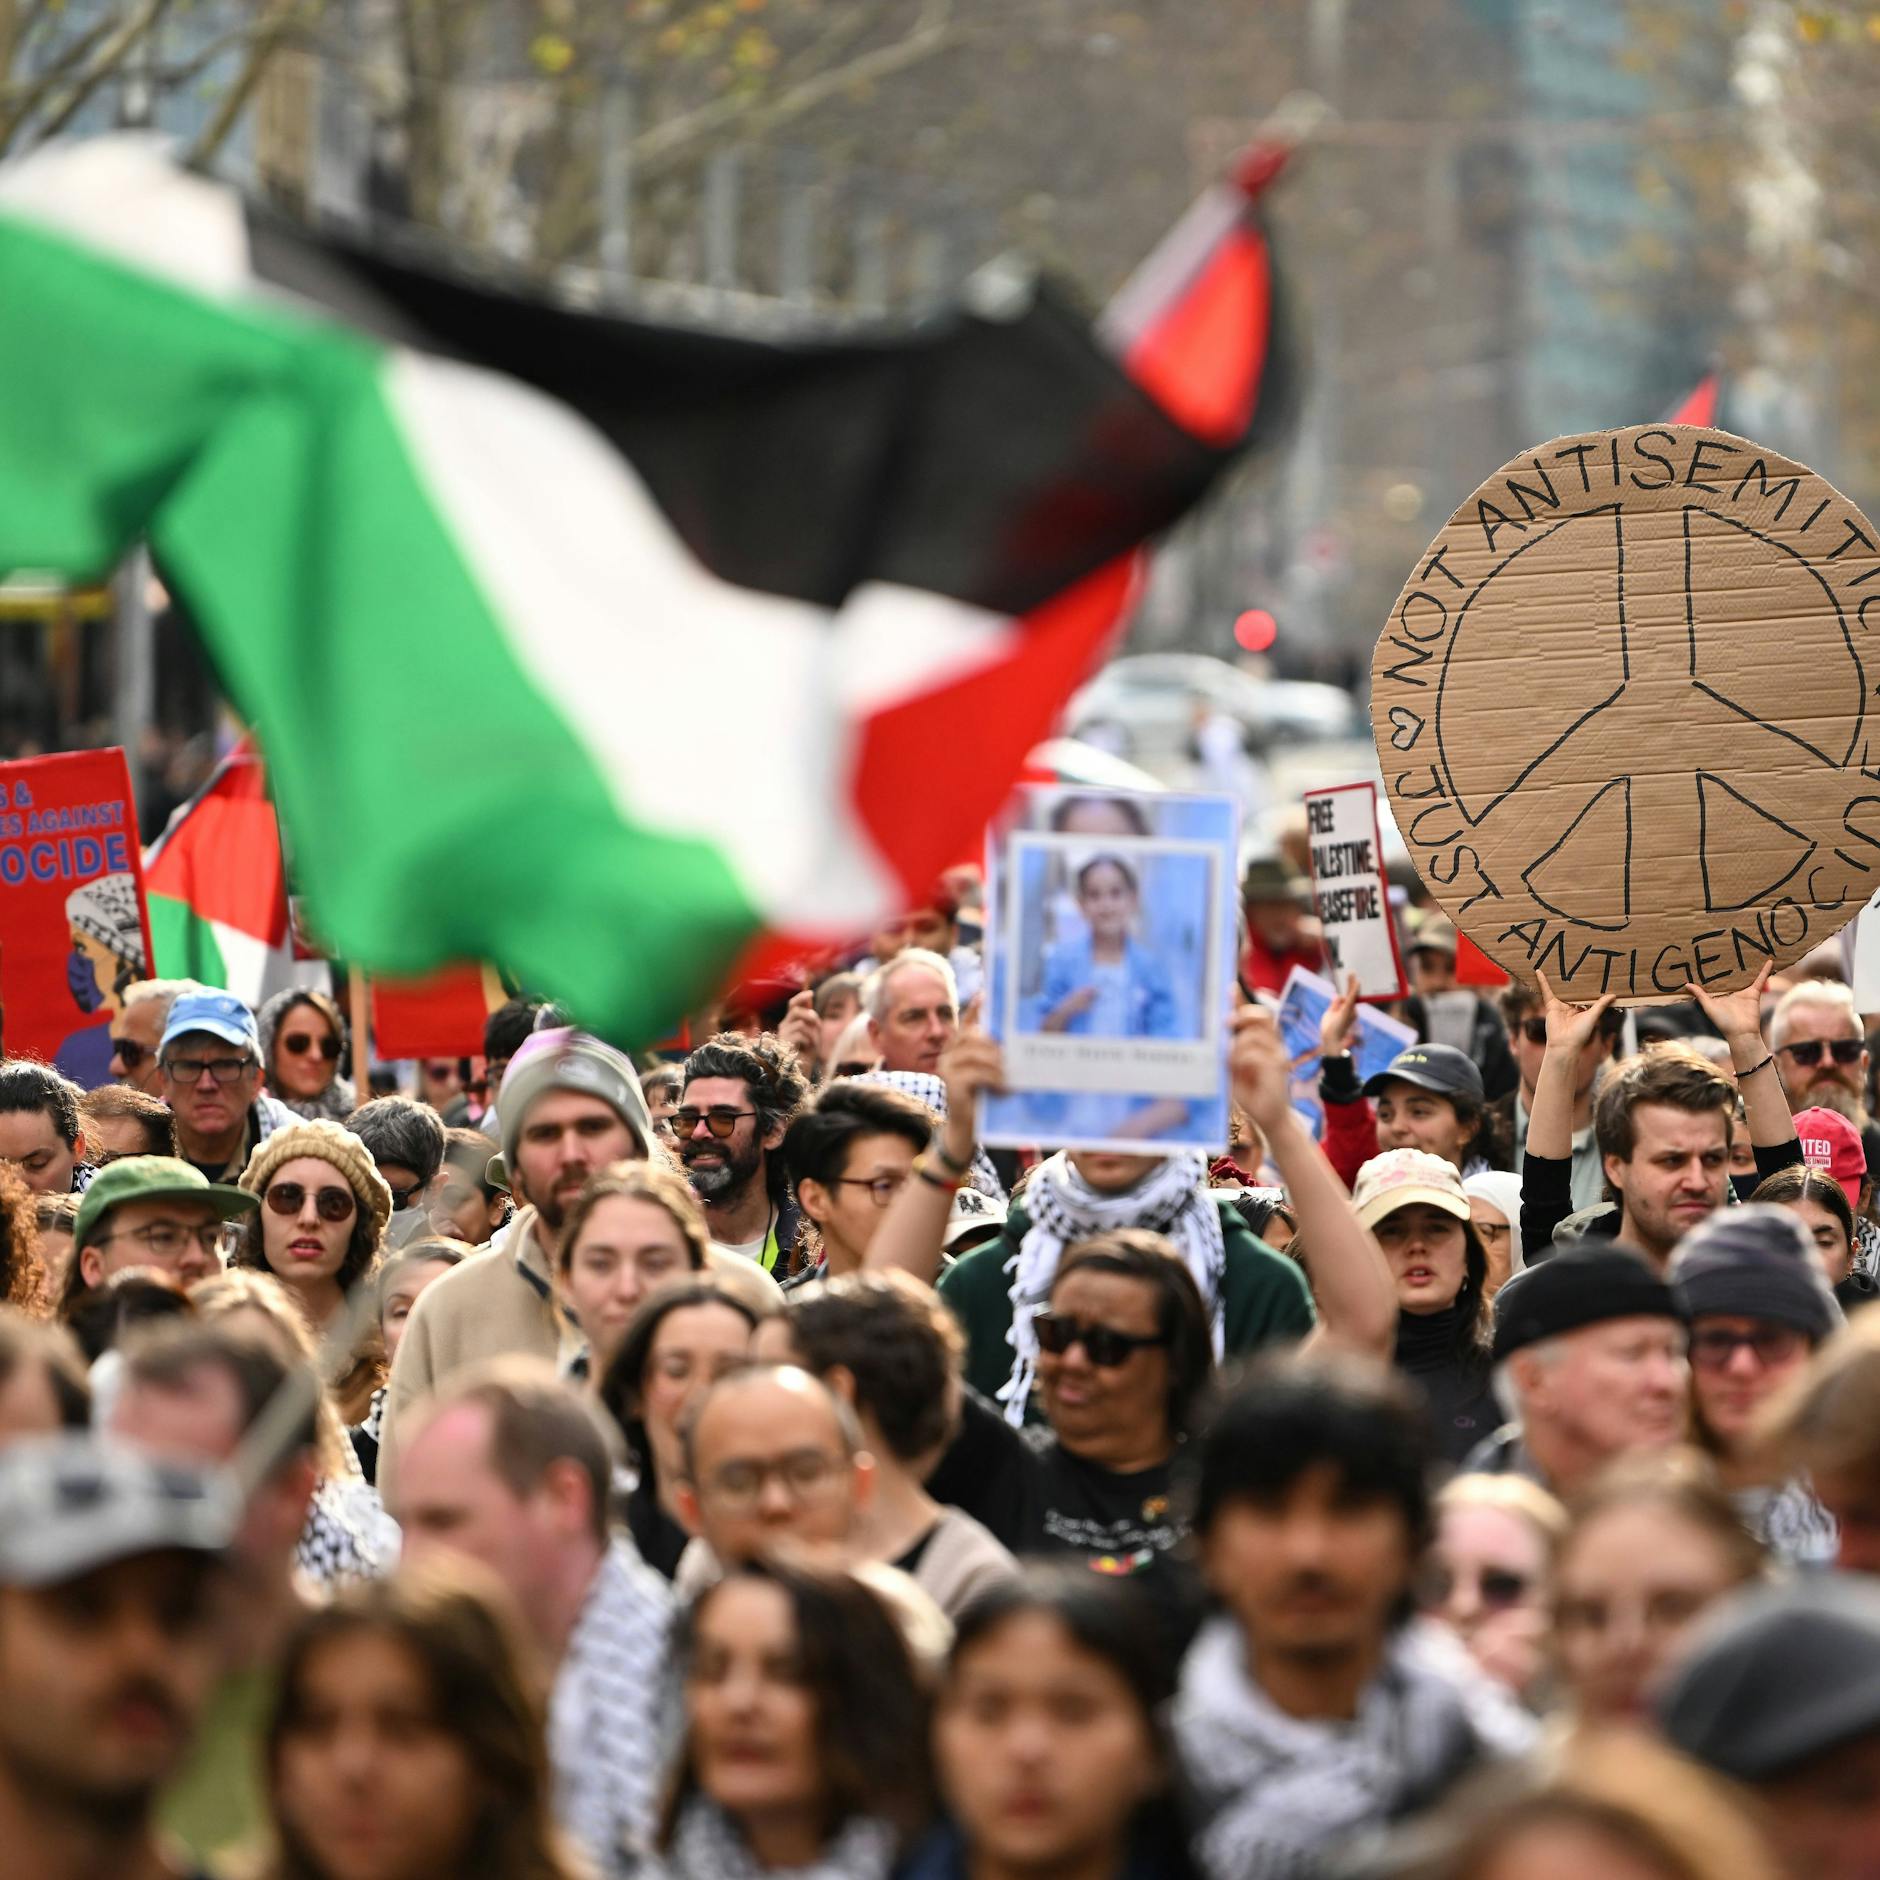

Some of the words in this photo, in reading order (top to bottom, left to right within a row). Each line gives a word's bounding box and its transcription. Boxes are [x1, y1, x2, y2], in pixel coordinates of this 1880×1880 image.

[1383, 545, 1463, 687] NOT
[15, 779, 33, 807] &
[28, 800, 124, 834] AGAINST
[1307, 798, 1335, 836] FREE
[1394, 764, 1504, 914] JUST
[0, 834, 128, 884] OCIDE
